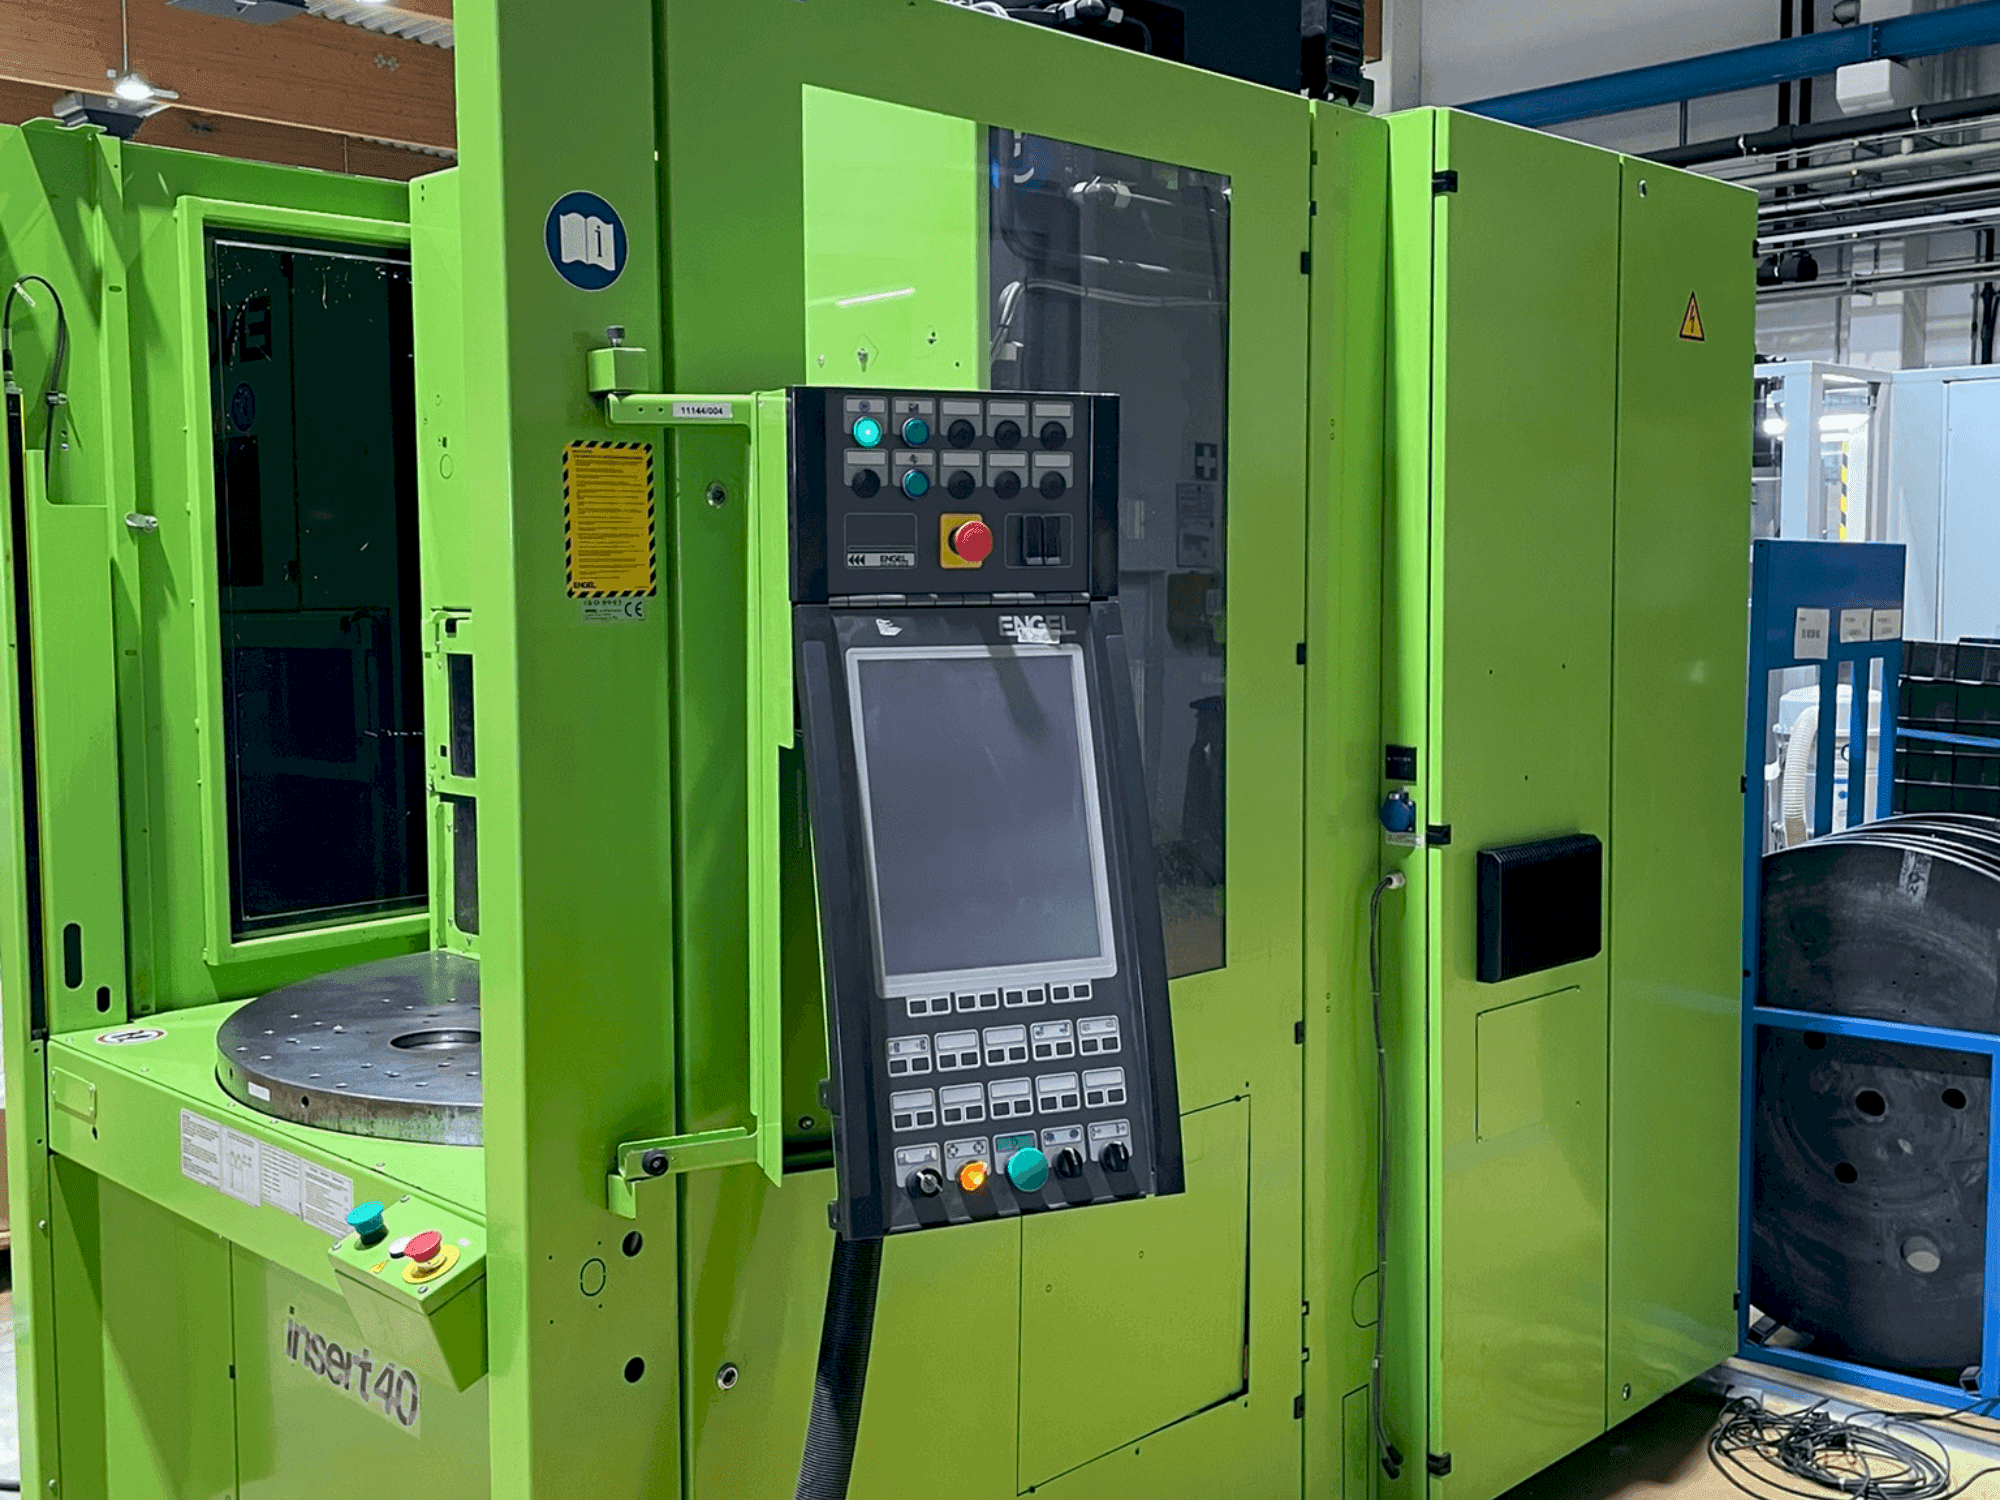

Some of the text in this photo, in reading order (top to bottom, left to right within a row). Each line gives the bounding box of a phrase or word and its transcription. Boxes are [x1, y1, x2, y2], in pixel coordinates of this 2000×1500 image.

[681, 406, 724, 415] 11144/004
[880, 555, 909, 563] ENGEL
[574, 581, 597, 589] ENGEL
[999, 614, 1077, 636] ENGEL
